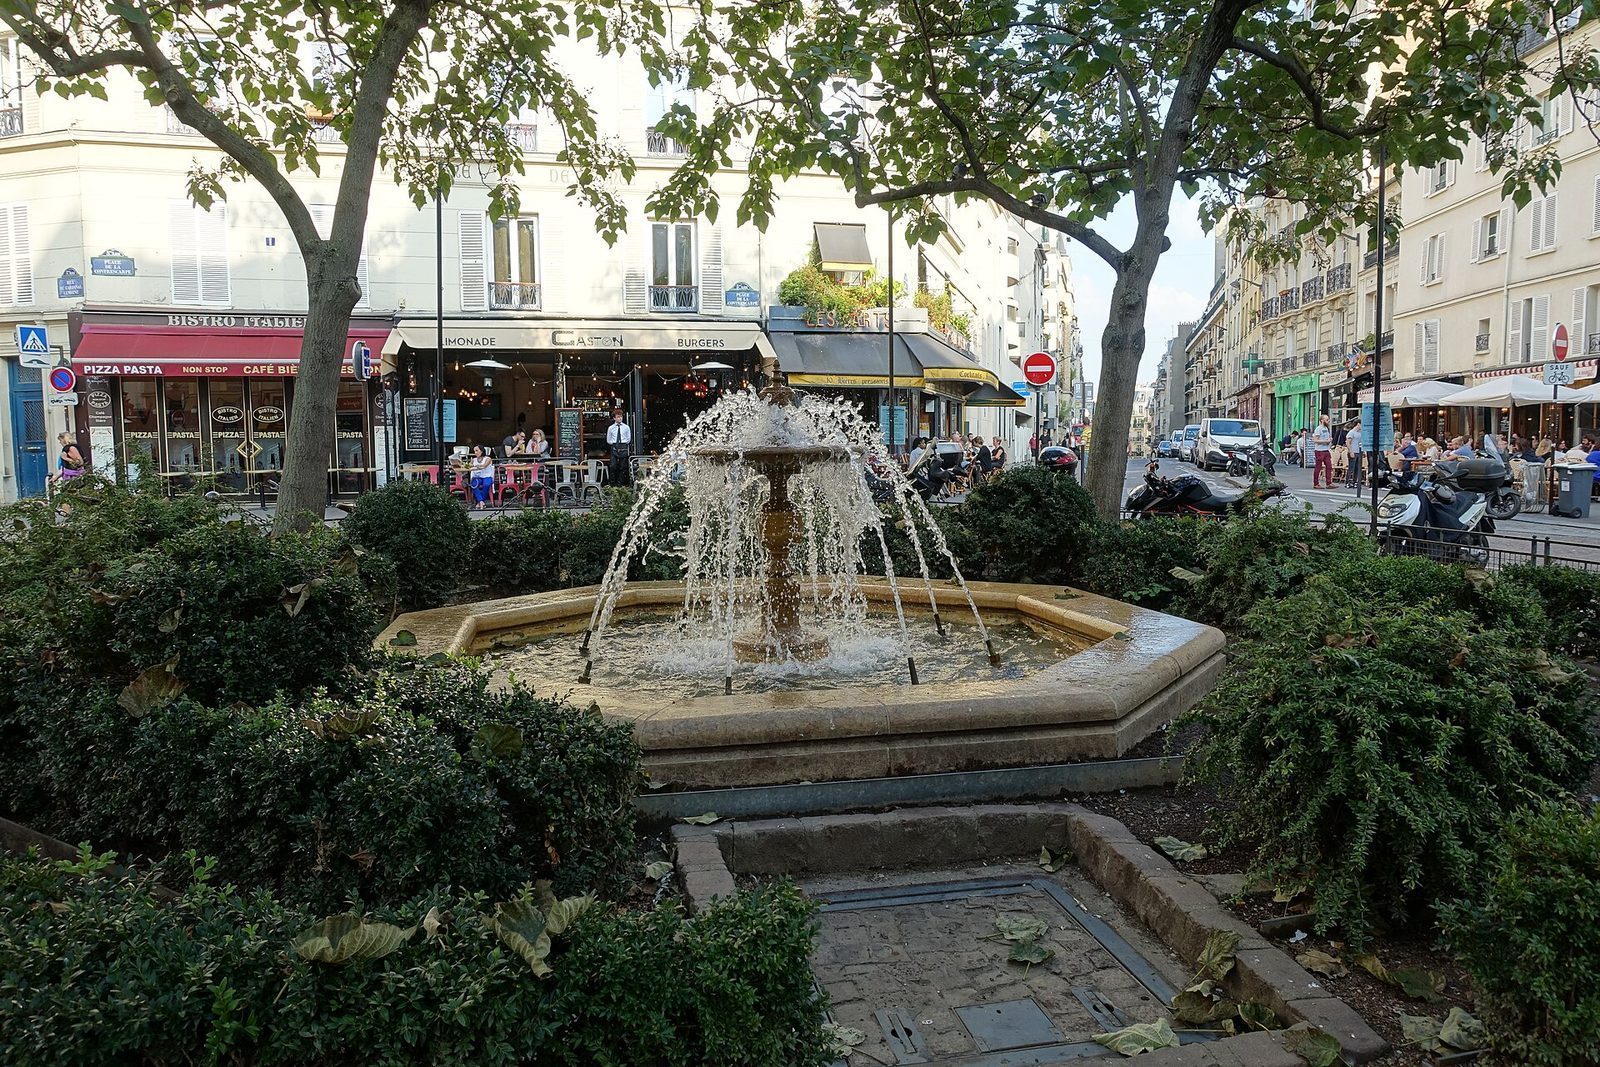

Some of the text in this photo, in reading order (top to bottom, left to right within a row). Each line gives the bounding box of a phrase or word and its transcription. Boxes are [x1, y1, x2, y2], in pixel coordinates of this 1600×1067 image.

[168, 315, 307, 329] BISTRO ITALIE
[442, 337, 496, 346] IMONADE
[677, 338, 725, 348] BURGERS
[83, 365, 163, 374] PIZZA PASTA
[243, 363, 275, 374] CAFÉ
[130, 431, 154, 439] PIZZA
[172, 431, 196, 439] PASTA
[218, 431, 240, 439] PIZZA
[259, 431, 280, 439] PASTA
[342, 431, 363, 439] PASTA
